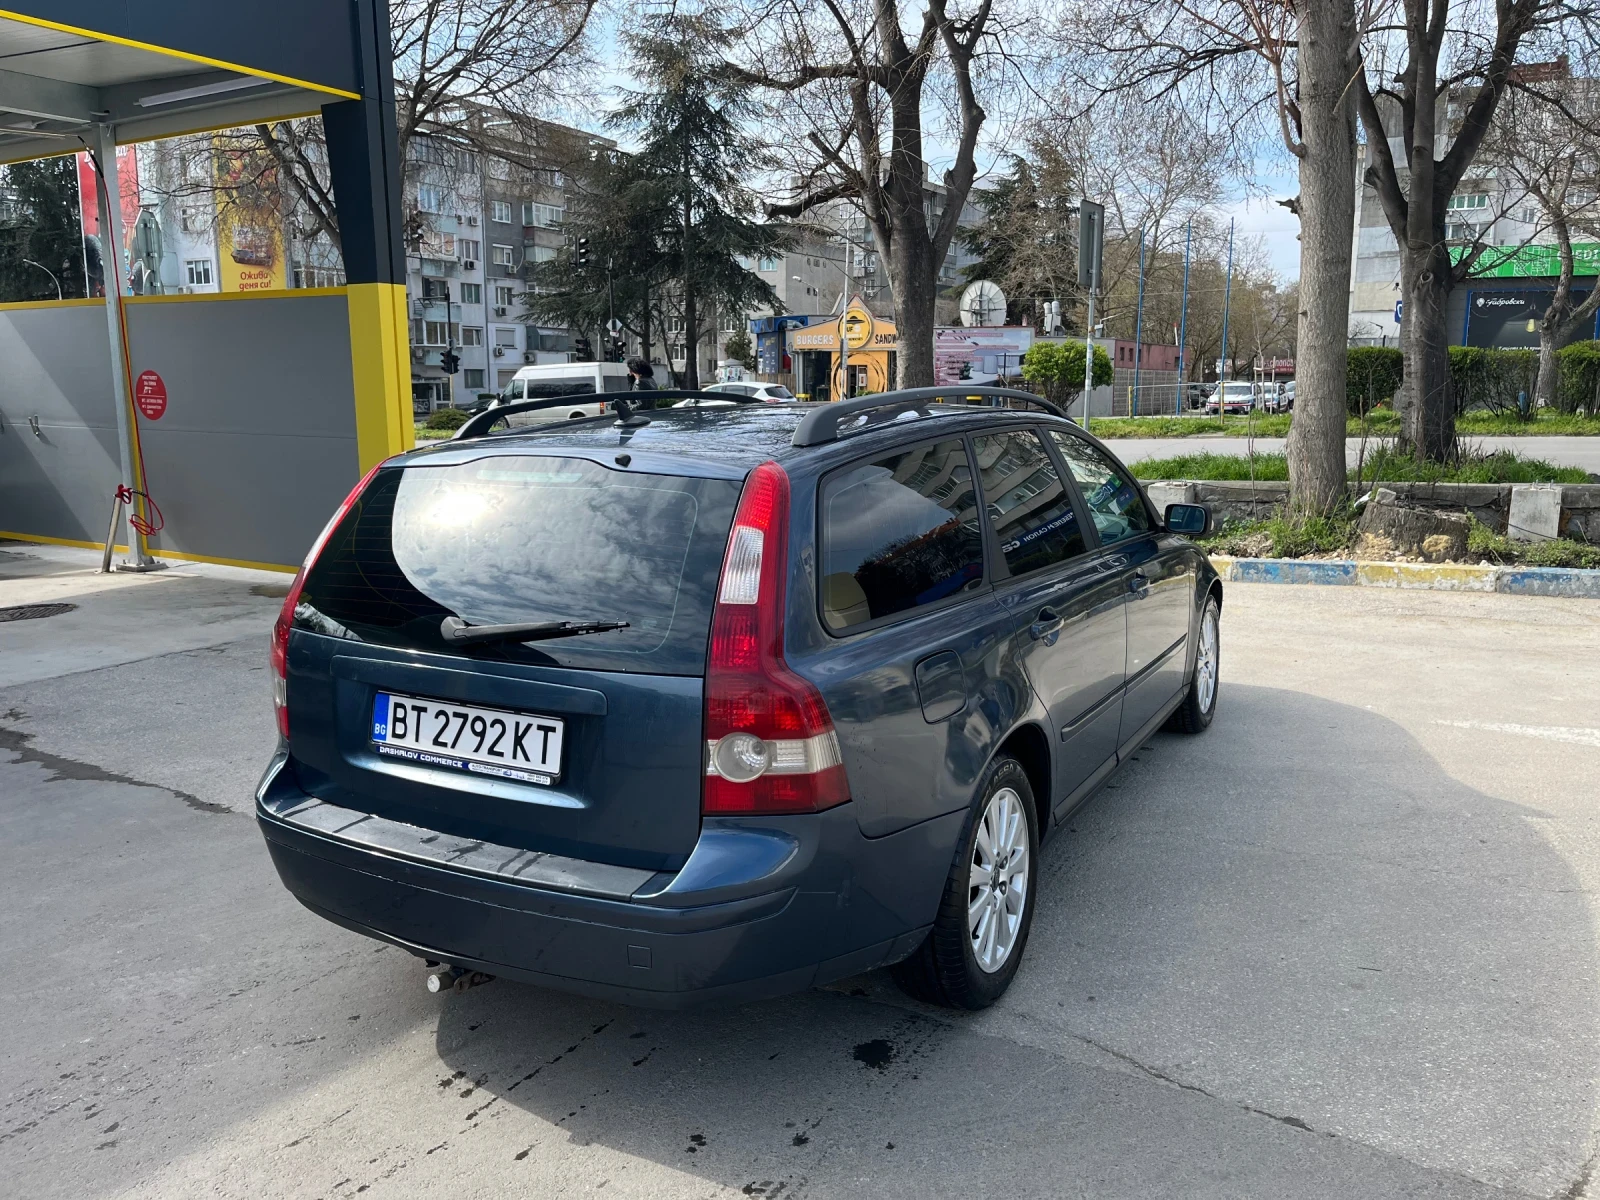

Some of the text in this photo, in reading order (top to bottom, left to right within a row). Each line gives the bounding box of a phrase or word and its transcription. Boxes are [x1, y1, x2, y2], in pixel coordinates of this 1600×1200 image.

[239, 283, 258, 292] деня
[796, 334, 834, 345] BURGERS
[374, 723, 387, 736] BG
[420, 754, 463, 768] COMMERCE
